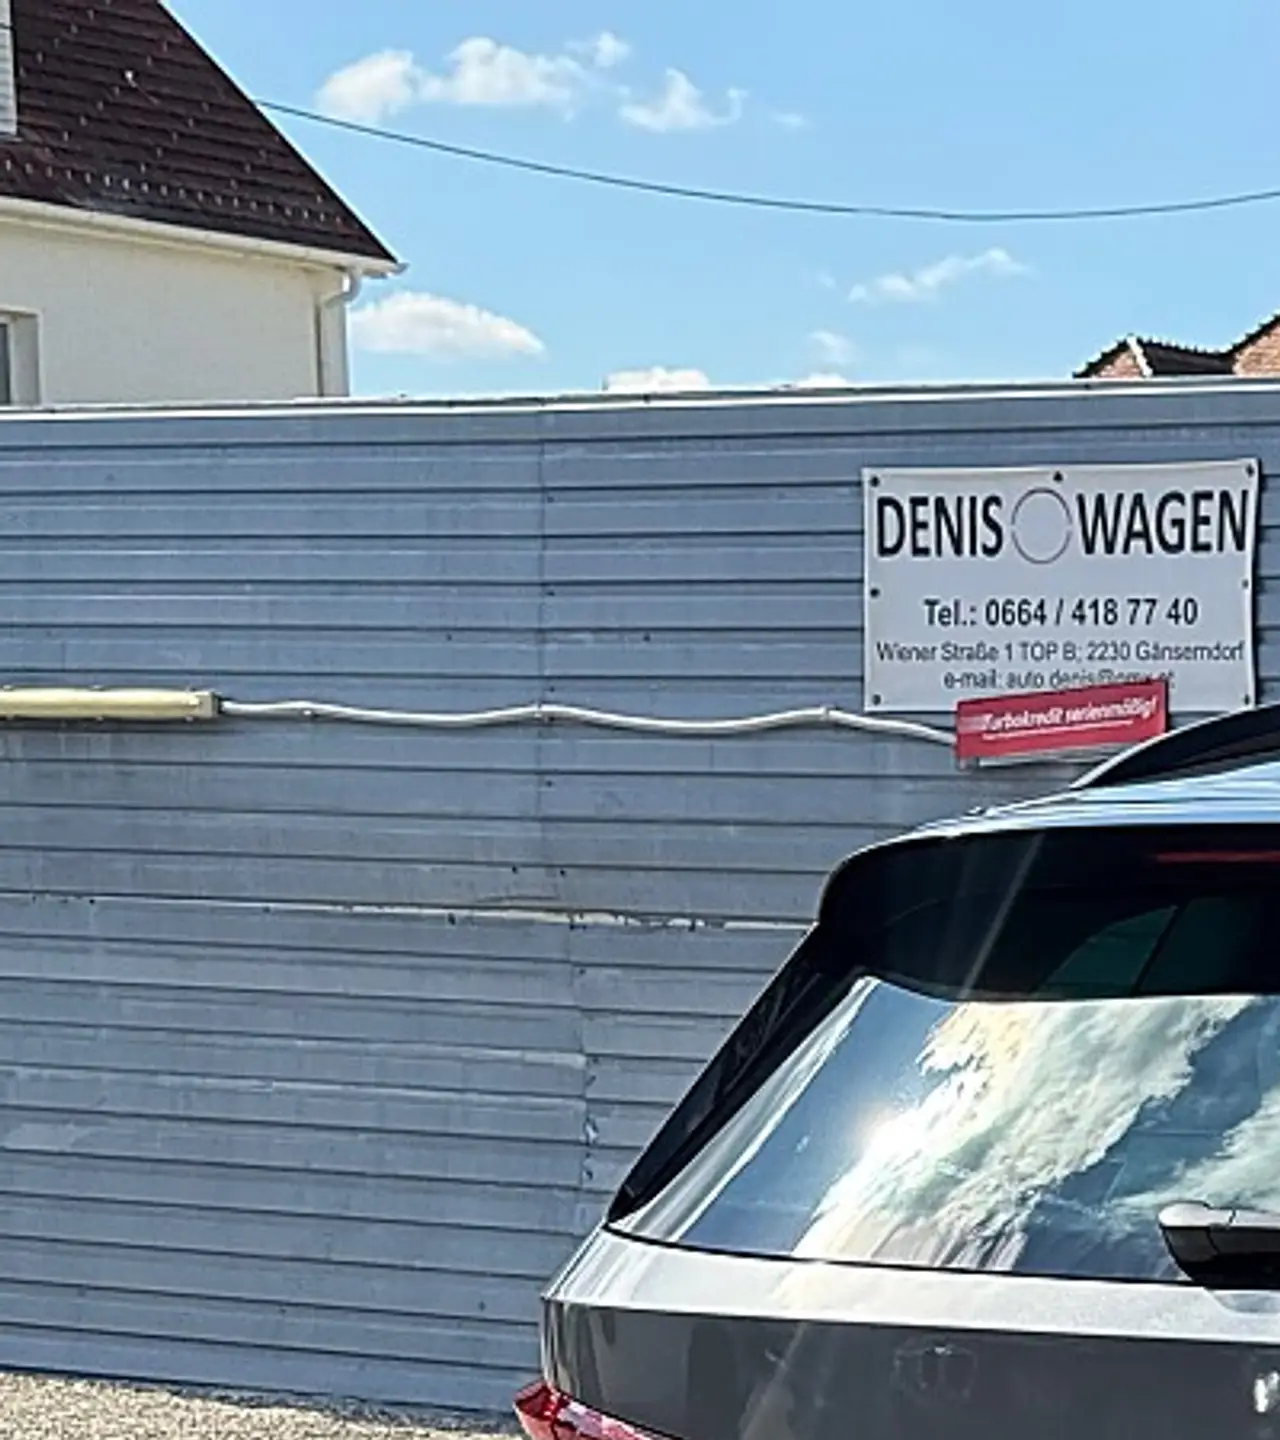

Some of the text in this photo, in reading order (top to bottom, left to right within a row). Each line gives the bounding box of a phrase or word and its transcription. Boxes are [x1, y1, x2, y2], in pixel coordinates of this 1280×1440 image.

[876, 489, 1250, 558] DENIS WAGEN
[924, 598, 1199, 628] Tel.: 0664 / 418 77 40
[876, 641, 937, 661] Wiener
[941, 641, 999, 662] Straße
[1005, 642, 1013, 661] 1
[1018, 641, 1058, 661] TOP
[1087, 641, 1131, 661] 2230
[1136, 639, 1246, 661] Gänserndorf
